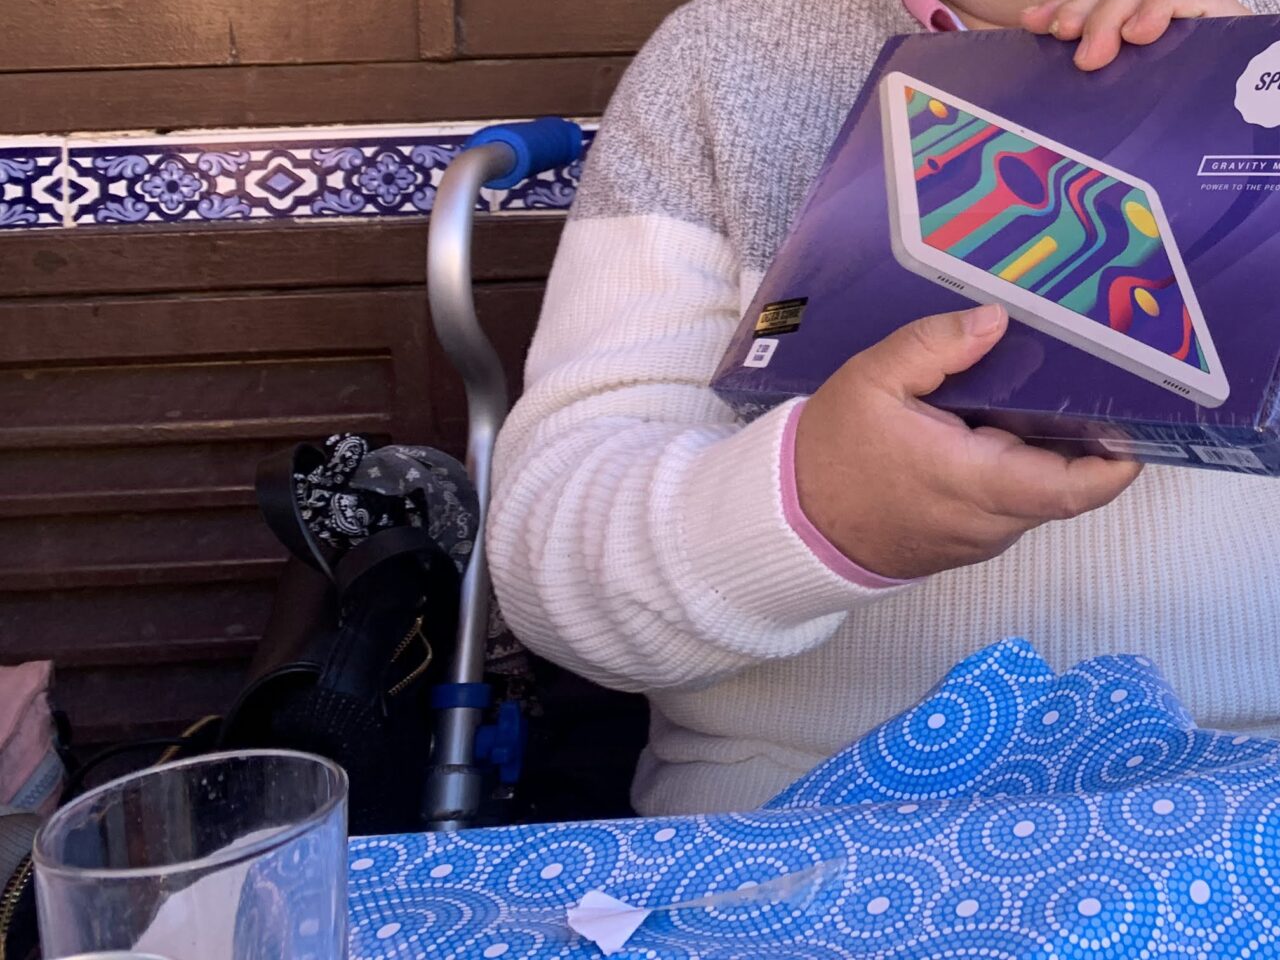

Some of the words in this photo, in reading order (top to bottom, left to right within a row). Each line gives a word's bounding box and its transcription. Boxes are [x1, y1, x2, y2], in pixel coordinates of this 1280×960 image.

[1211, 161, 1268, 171] GRAVITY
[1200, 183, 1229, 191] POWER
[1232, 183, 1243, 191] TO
[1246, 183, 1261, 191] THE
